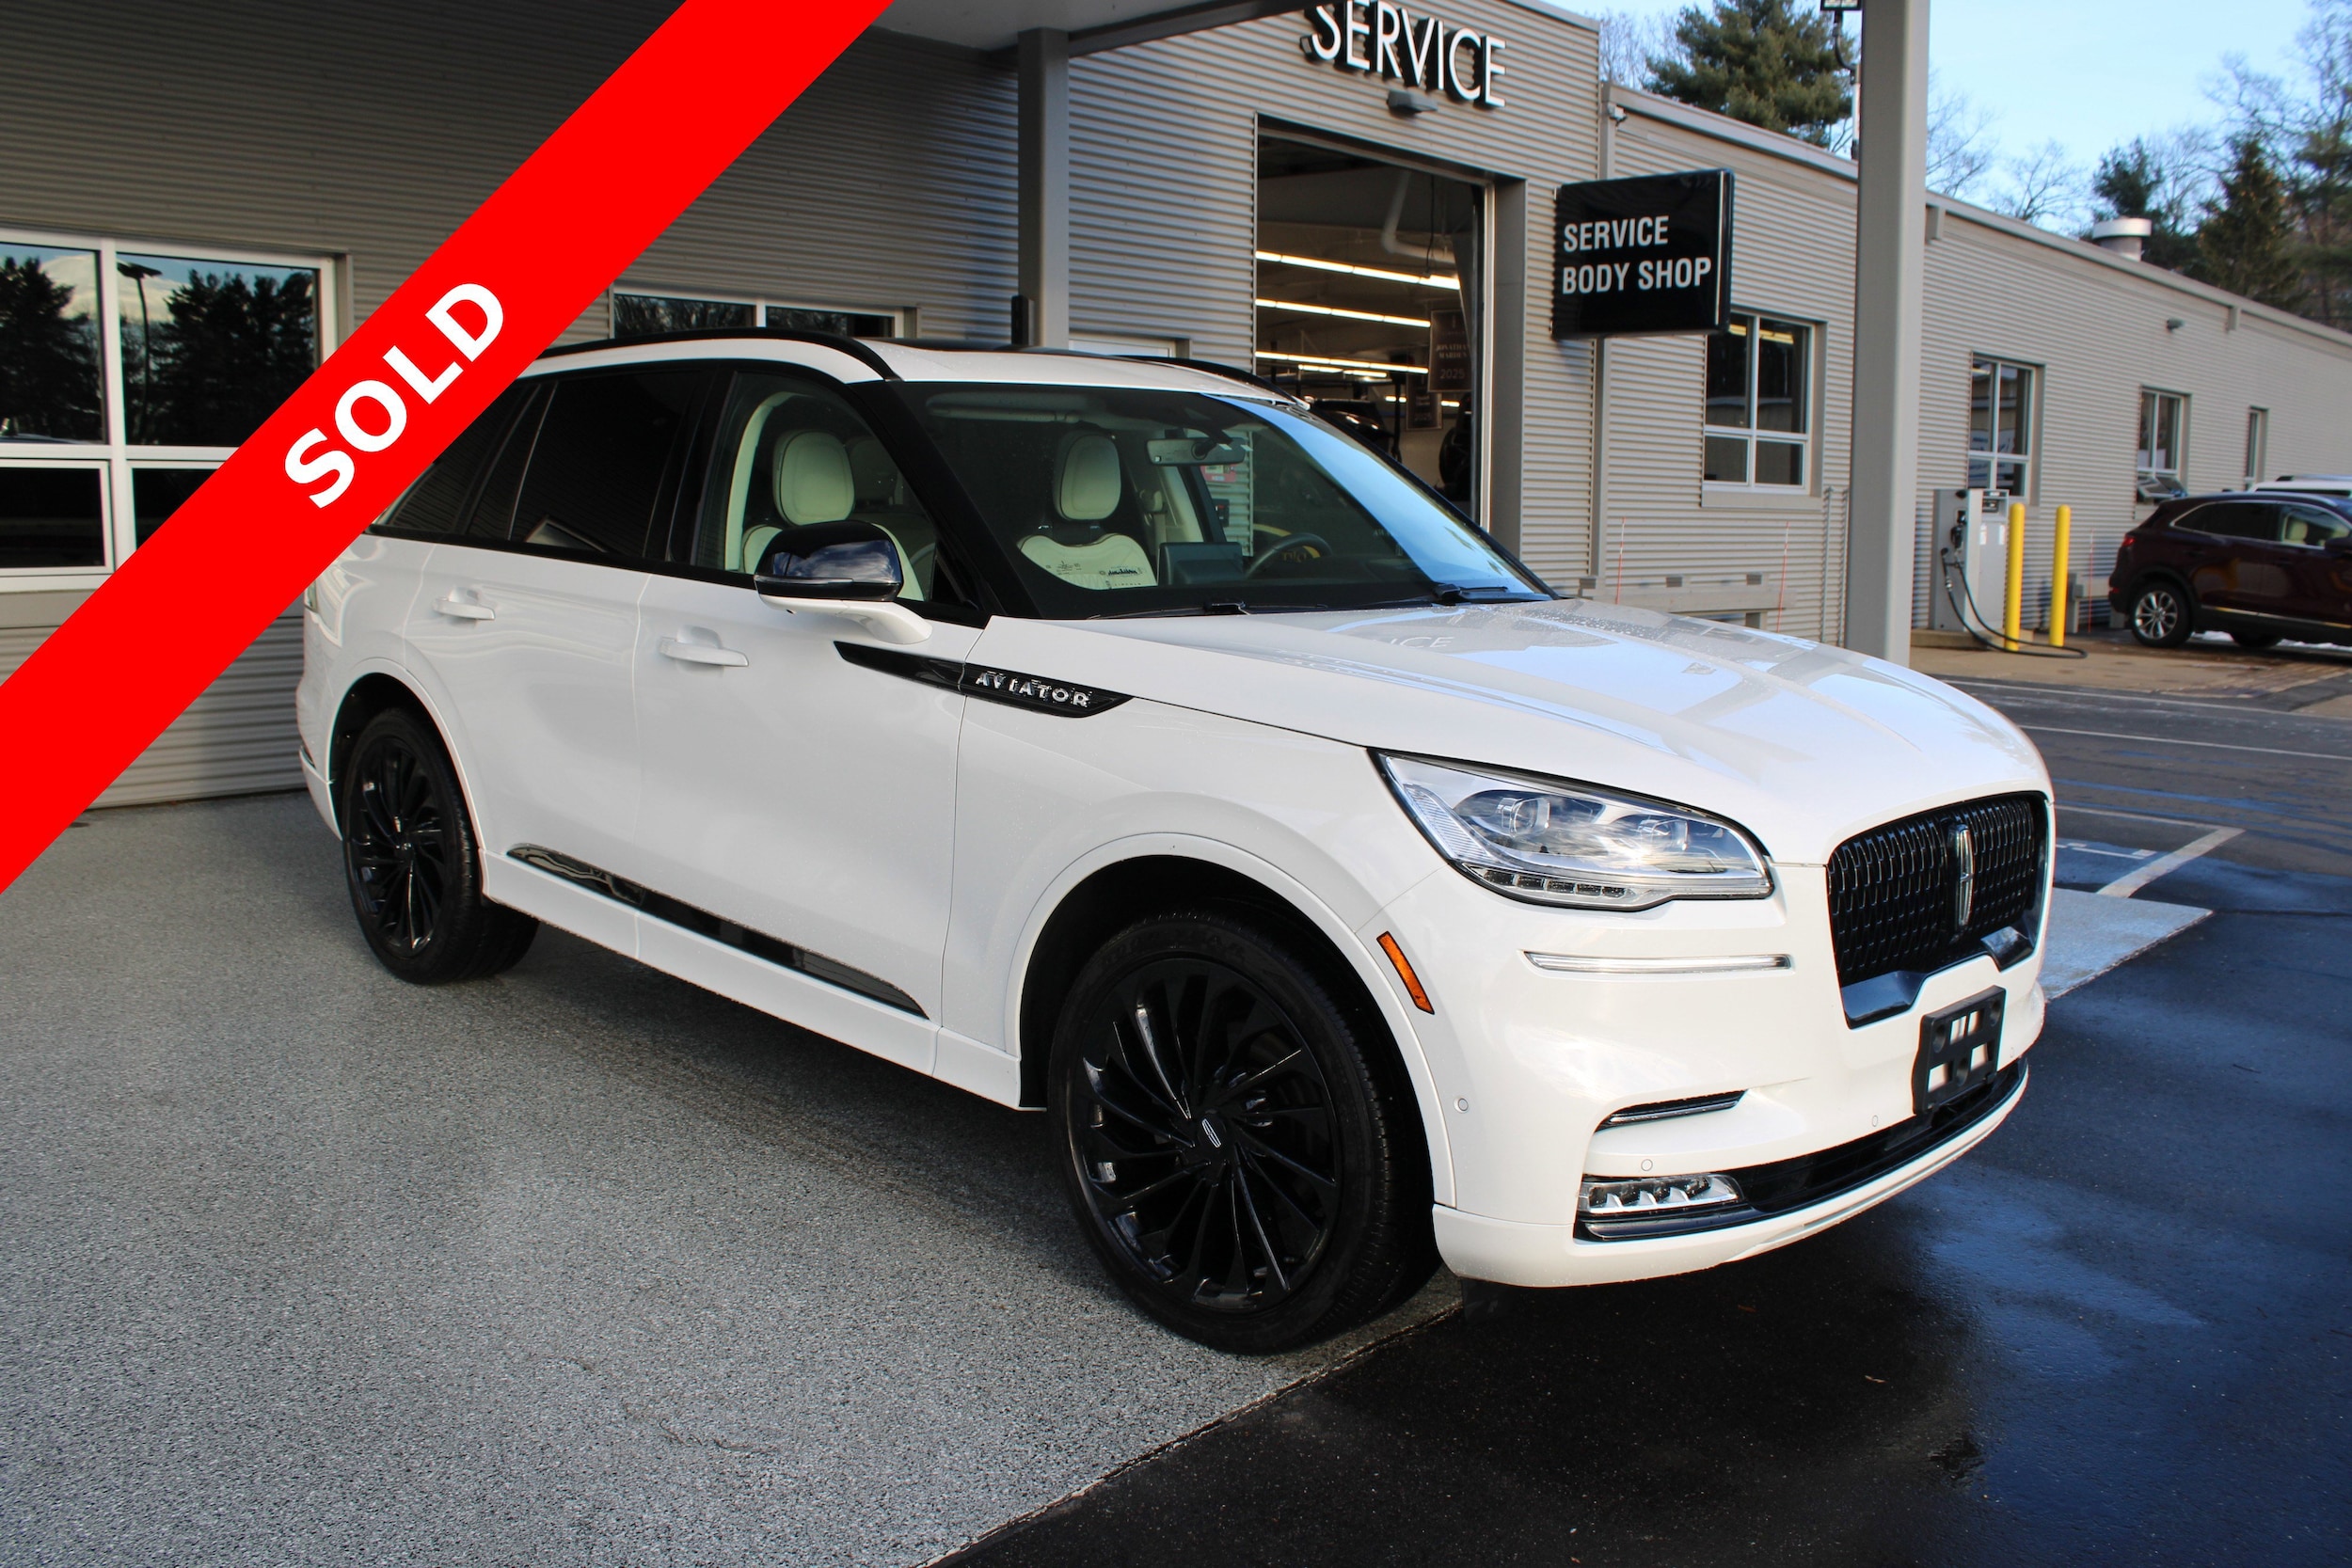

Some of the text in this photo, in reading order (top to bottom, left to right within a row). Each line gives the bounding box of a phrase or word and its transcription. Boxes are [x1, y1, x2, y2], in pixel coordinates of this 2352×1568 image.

[1311, 0, 1506, 107] SERVICE
[1563, 215, 1670, 252] SERVICE
[1562, 257, 1711, 294] BODY SHOP
[1439, 369, 1466, 380] 2025
[975, 671, 1091, 707] AVIATOR
